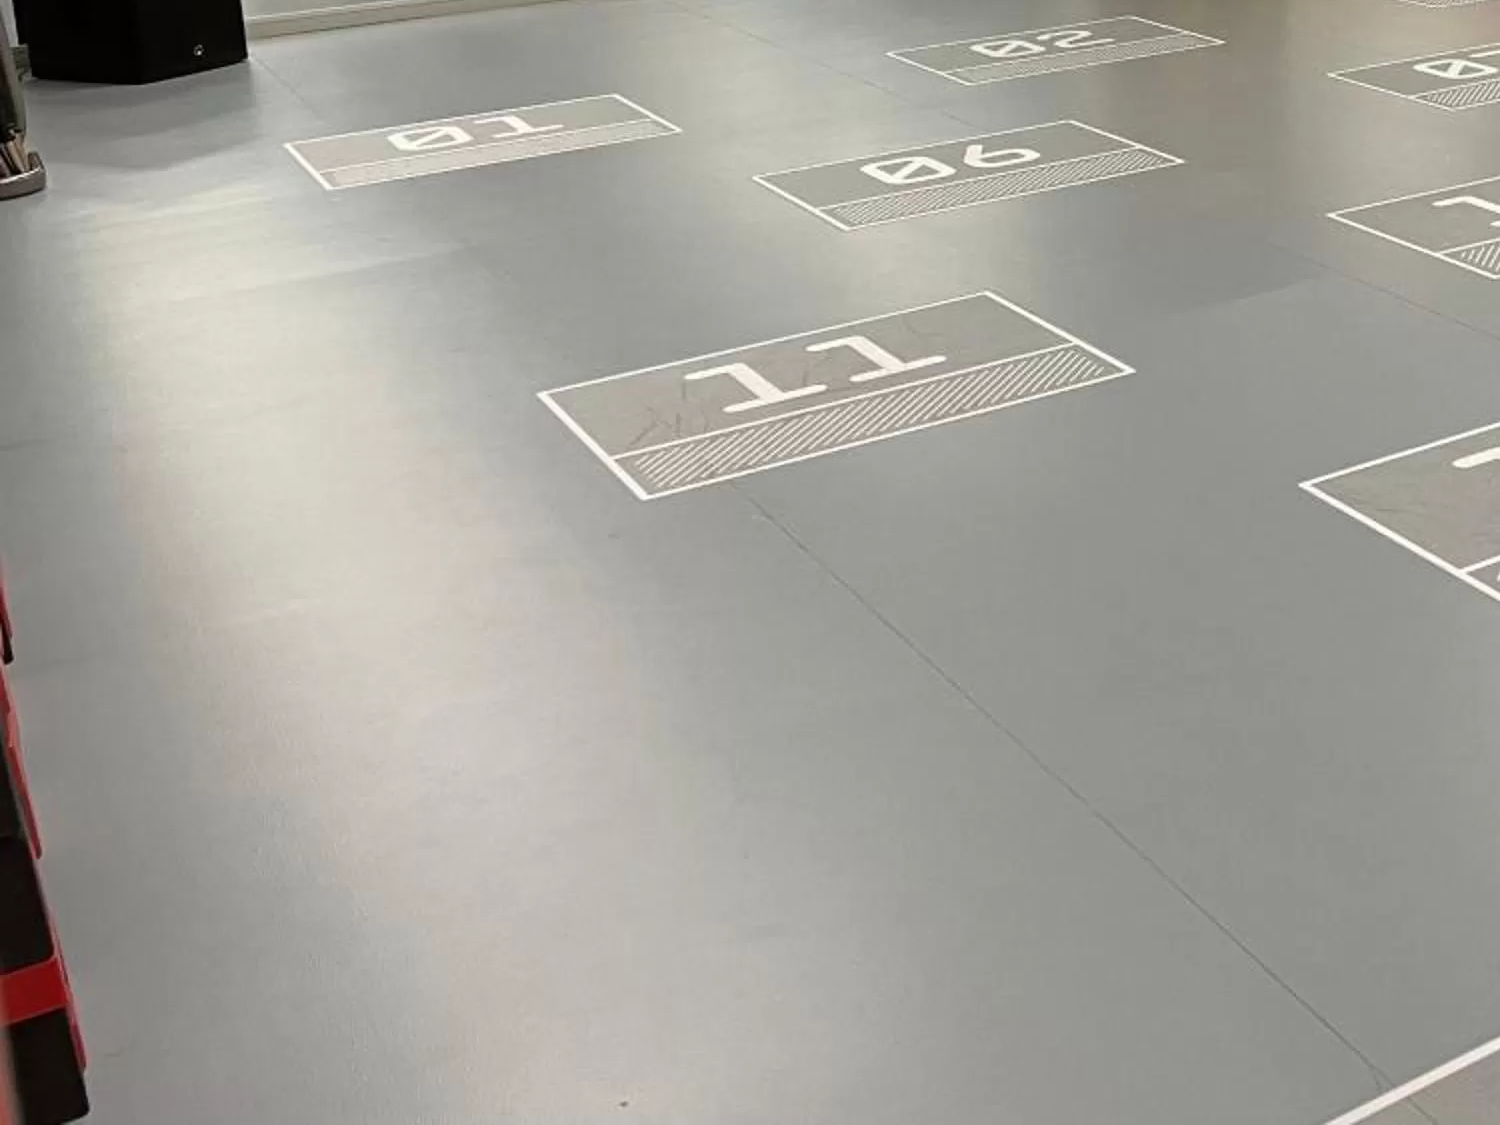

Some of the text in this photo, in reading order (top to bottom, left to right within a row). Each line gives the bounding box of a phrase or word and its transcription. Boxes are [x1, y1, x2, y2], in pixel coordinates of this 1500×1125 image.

[967, 30, 1116, 58] 02
[383, 114, 567, 152] 01
[858, 144, 1041, 185] 06
[683, 334, 947, 413] 11
